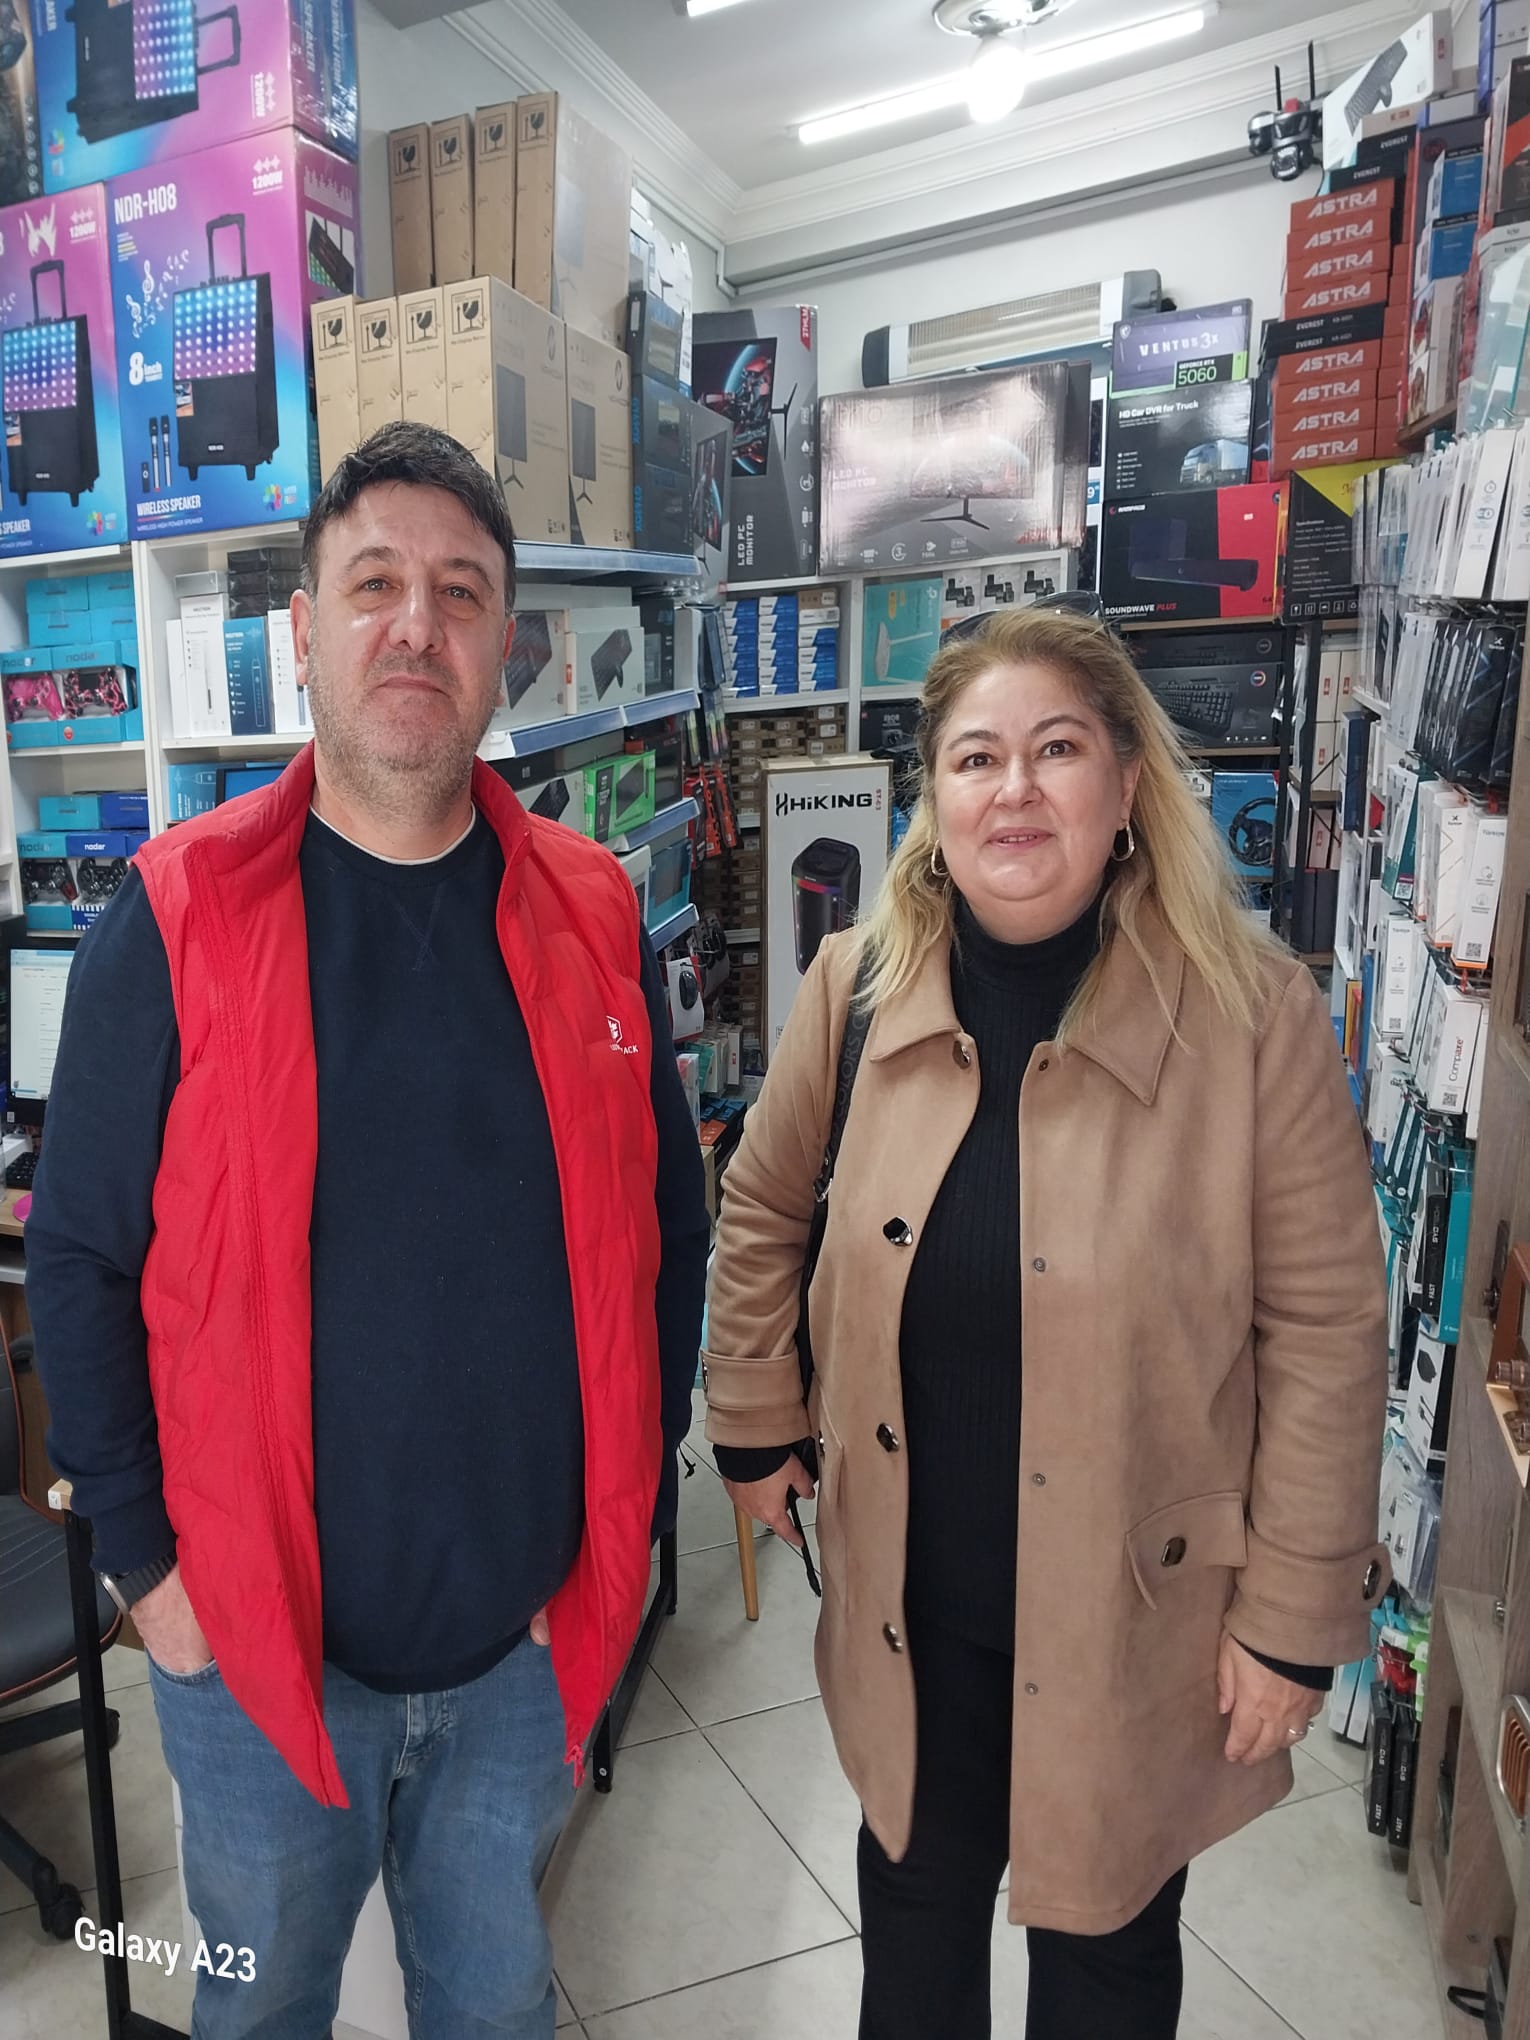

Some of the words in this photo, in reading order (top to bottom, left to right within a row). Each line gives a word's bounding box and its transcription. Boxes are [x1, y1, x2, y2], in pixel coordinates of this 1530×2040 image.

[114, 183, 178, 225] NDR-H08
[1307, 188, 1377, 218] ASTRA
[1304, 219, 1373, 249] ASTRA
[1304, 250, 1373, 279] ASTRA
[1302, 281, 1371, 309] ASTRA
[1139, 337, 1199, 357] VENTUS
[129, 352, 144, 386] 8
[1295, 349, 1364, 374] ASTRA
[1178, 367, 1217, 385] 5060
[1292, 379, 1360, 403] ASTRA
[1131, 408, 1146, 418] Car
[1146, 405, 1162, 416] DVR
[1162, 403, 1175, 412] for
[1176, 400, 1199, 411] Truck
[1292, 408, 1360, 432] ASTRA
[1291, 438, 1359, 461] ASTRA
[137, 499, 170, 516] WIRELESS
[170, 495, 201, 512] SPEAKER
[2, 519, 32, 534] SPEAKER
[737, 525, 745, 540] PC
[745, 515, 754, 566] MONITOR
[737, 543, 745, 566] LED
[1105, 602, 1155, 615] SOUNDWAVE
[1156, 602, 1176, 611] PLUS
[791, 793, 873, 811] HiKING
[1448, 1038, 1464, 1082] Compaxe
[1395, 1816, 1403, 1833] FAST
